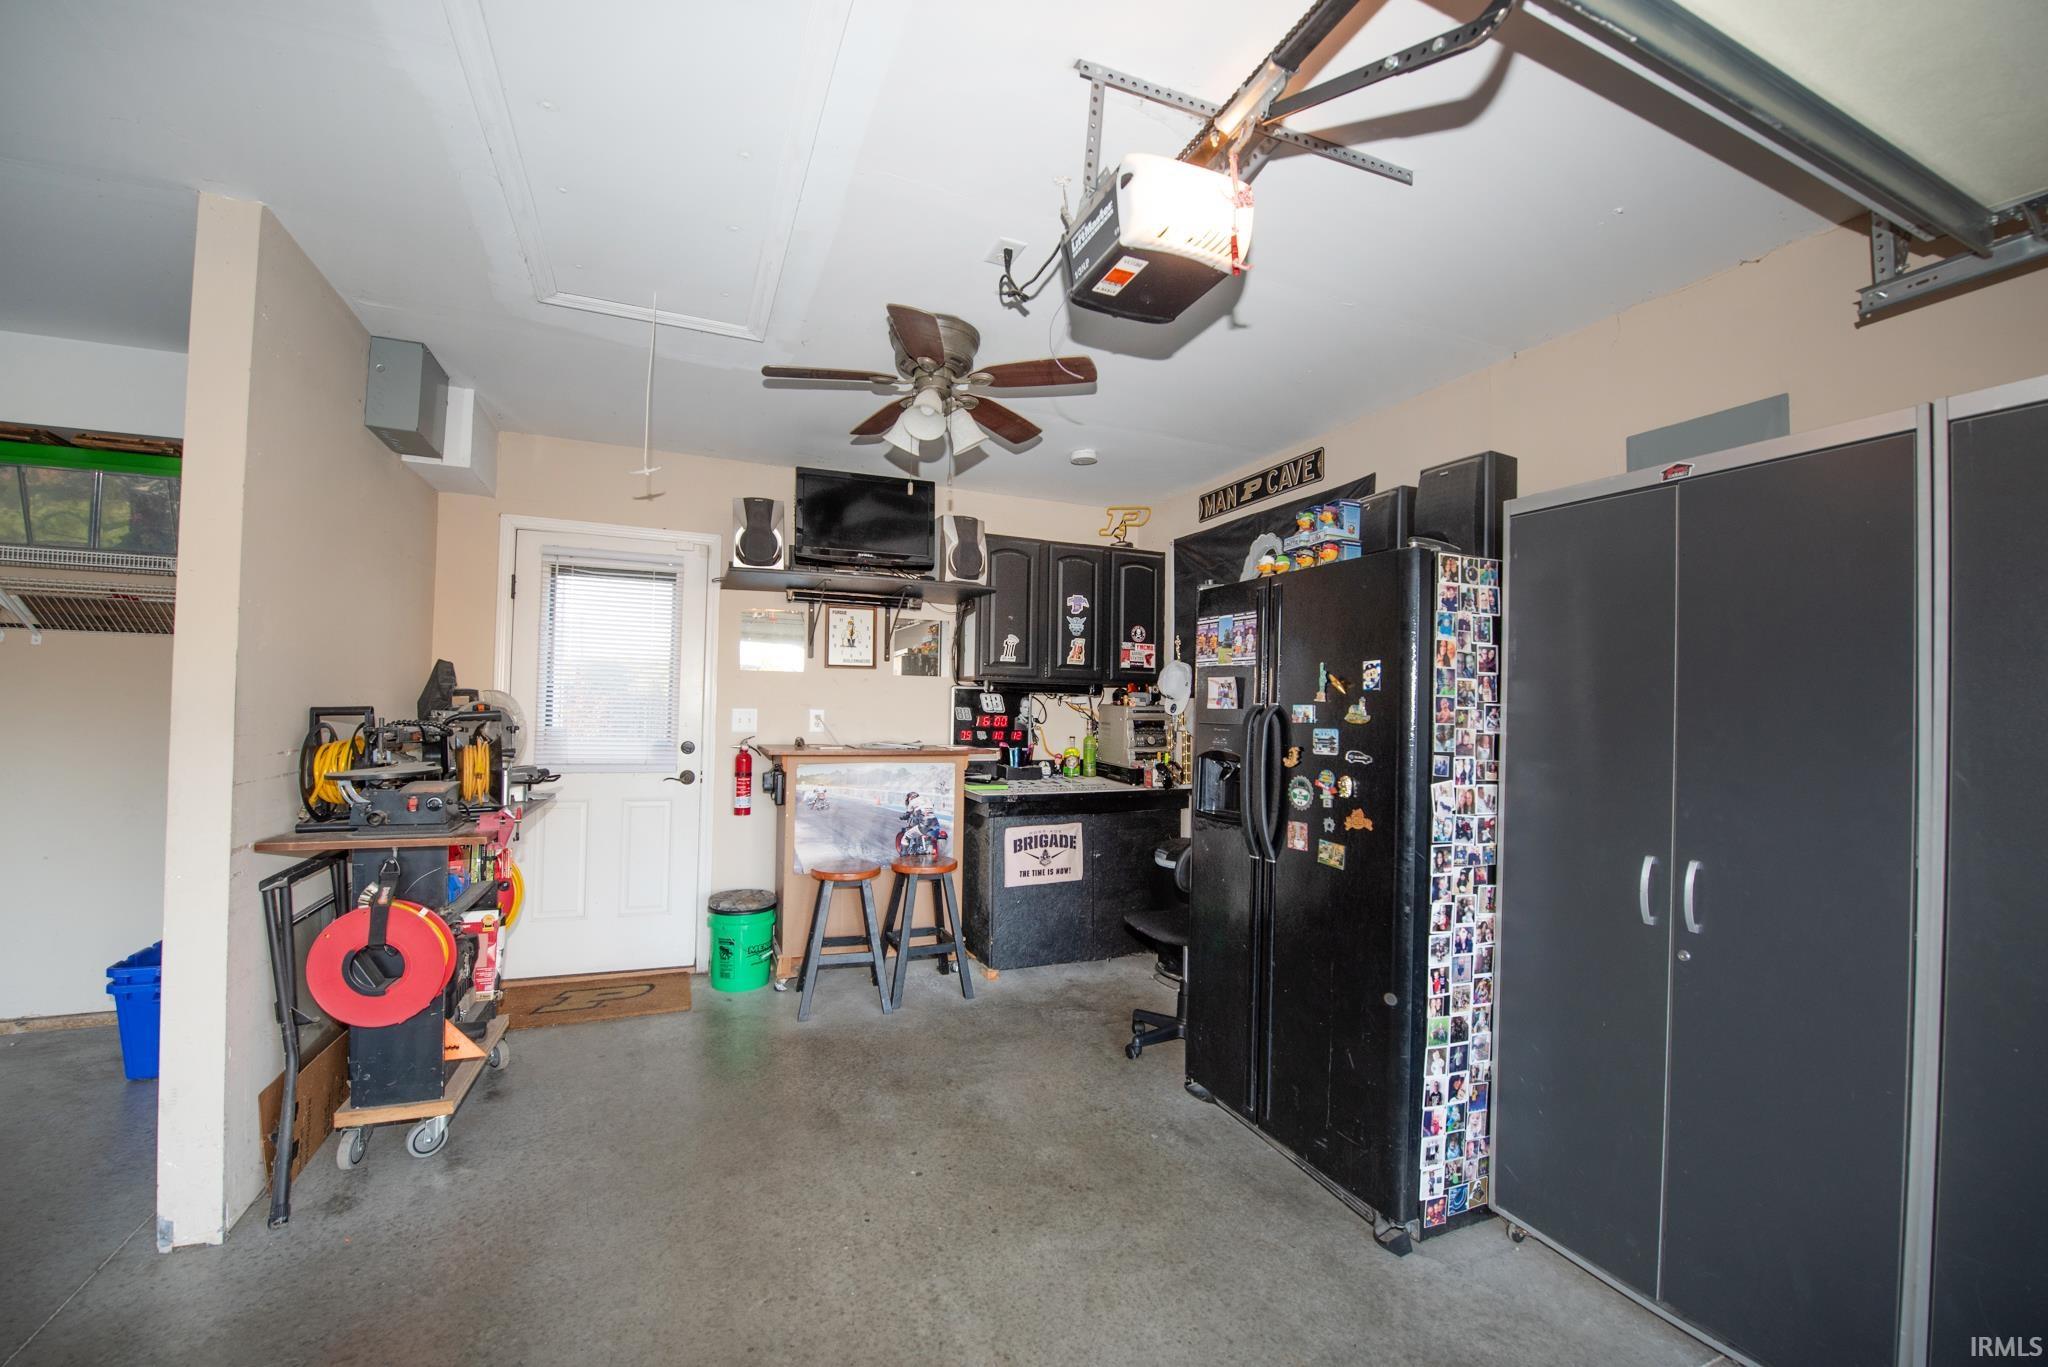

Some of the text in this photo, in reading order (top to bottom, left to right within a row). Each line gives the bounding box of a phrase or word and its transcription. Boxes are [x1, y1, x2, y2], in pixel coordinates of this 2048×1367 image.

[1205, 484, 1237, 517] MAN
[1266, 454, 1314, 495] CAVE
[1013, 834, 1077, 854] BRIGADE
[1019, 867, 1072, 878] THE TIME IS NOW!
